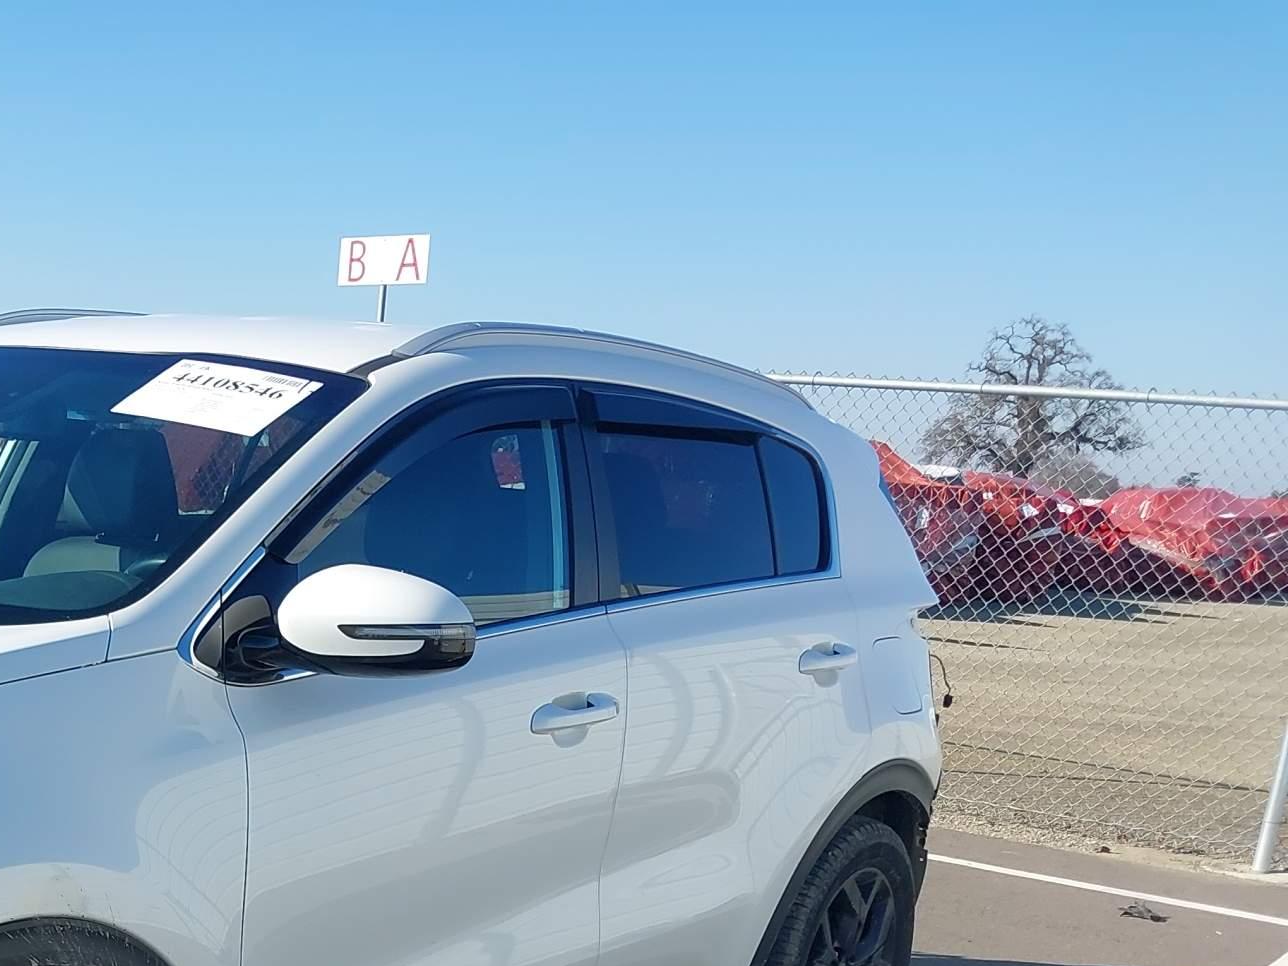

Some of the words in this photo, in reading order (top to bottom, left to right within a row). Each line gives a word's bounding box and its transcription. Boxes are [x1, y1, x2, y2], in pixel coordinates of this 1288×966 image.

[348, 240, 366, 282] B
[395, 237, 420, 281] A
[173, 372, 284, 400] 44108546
